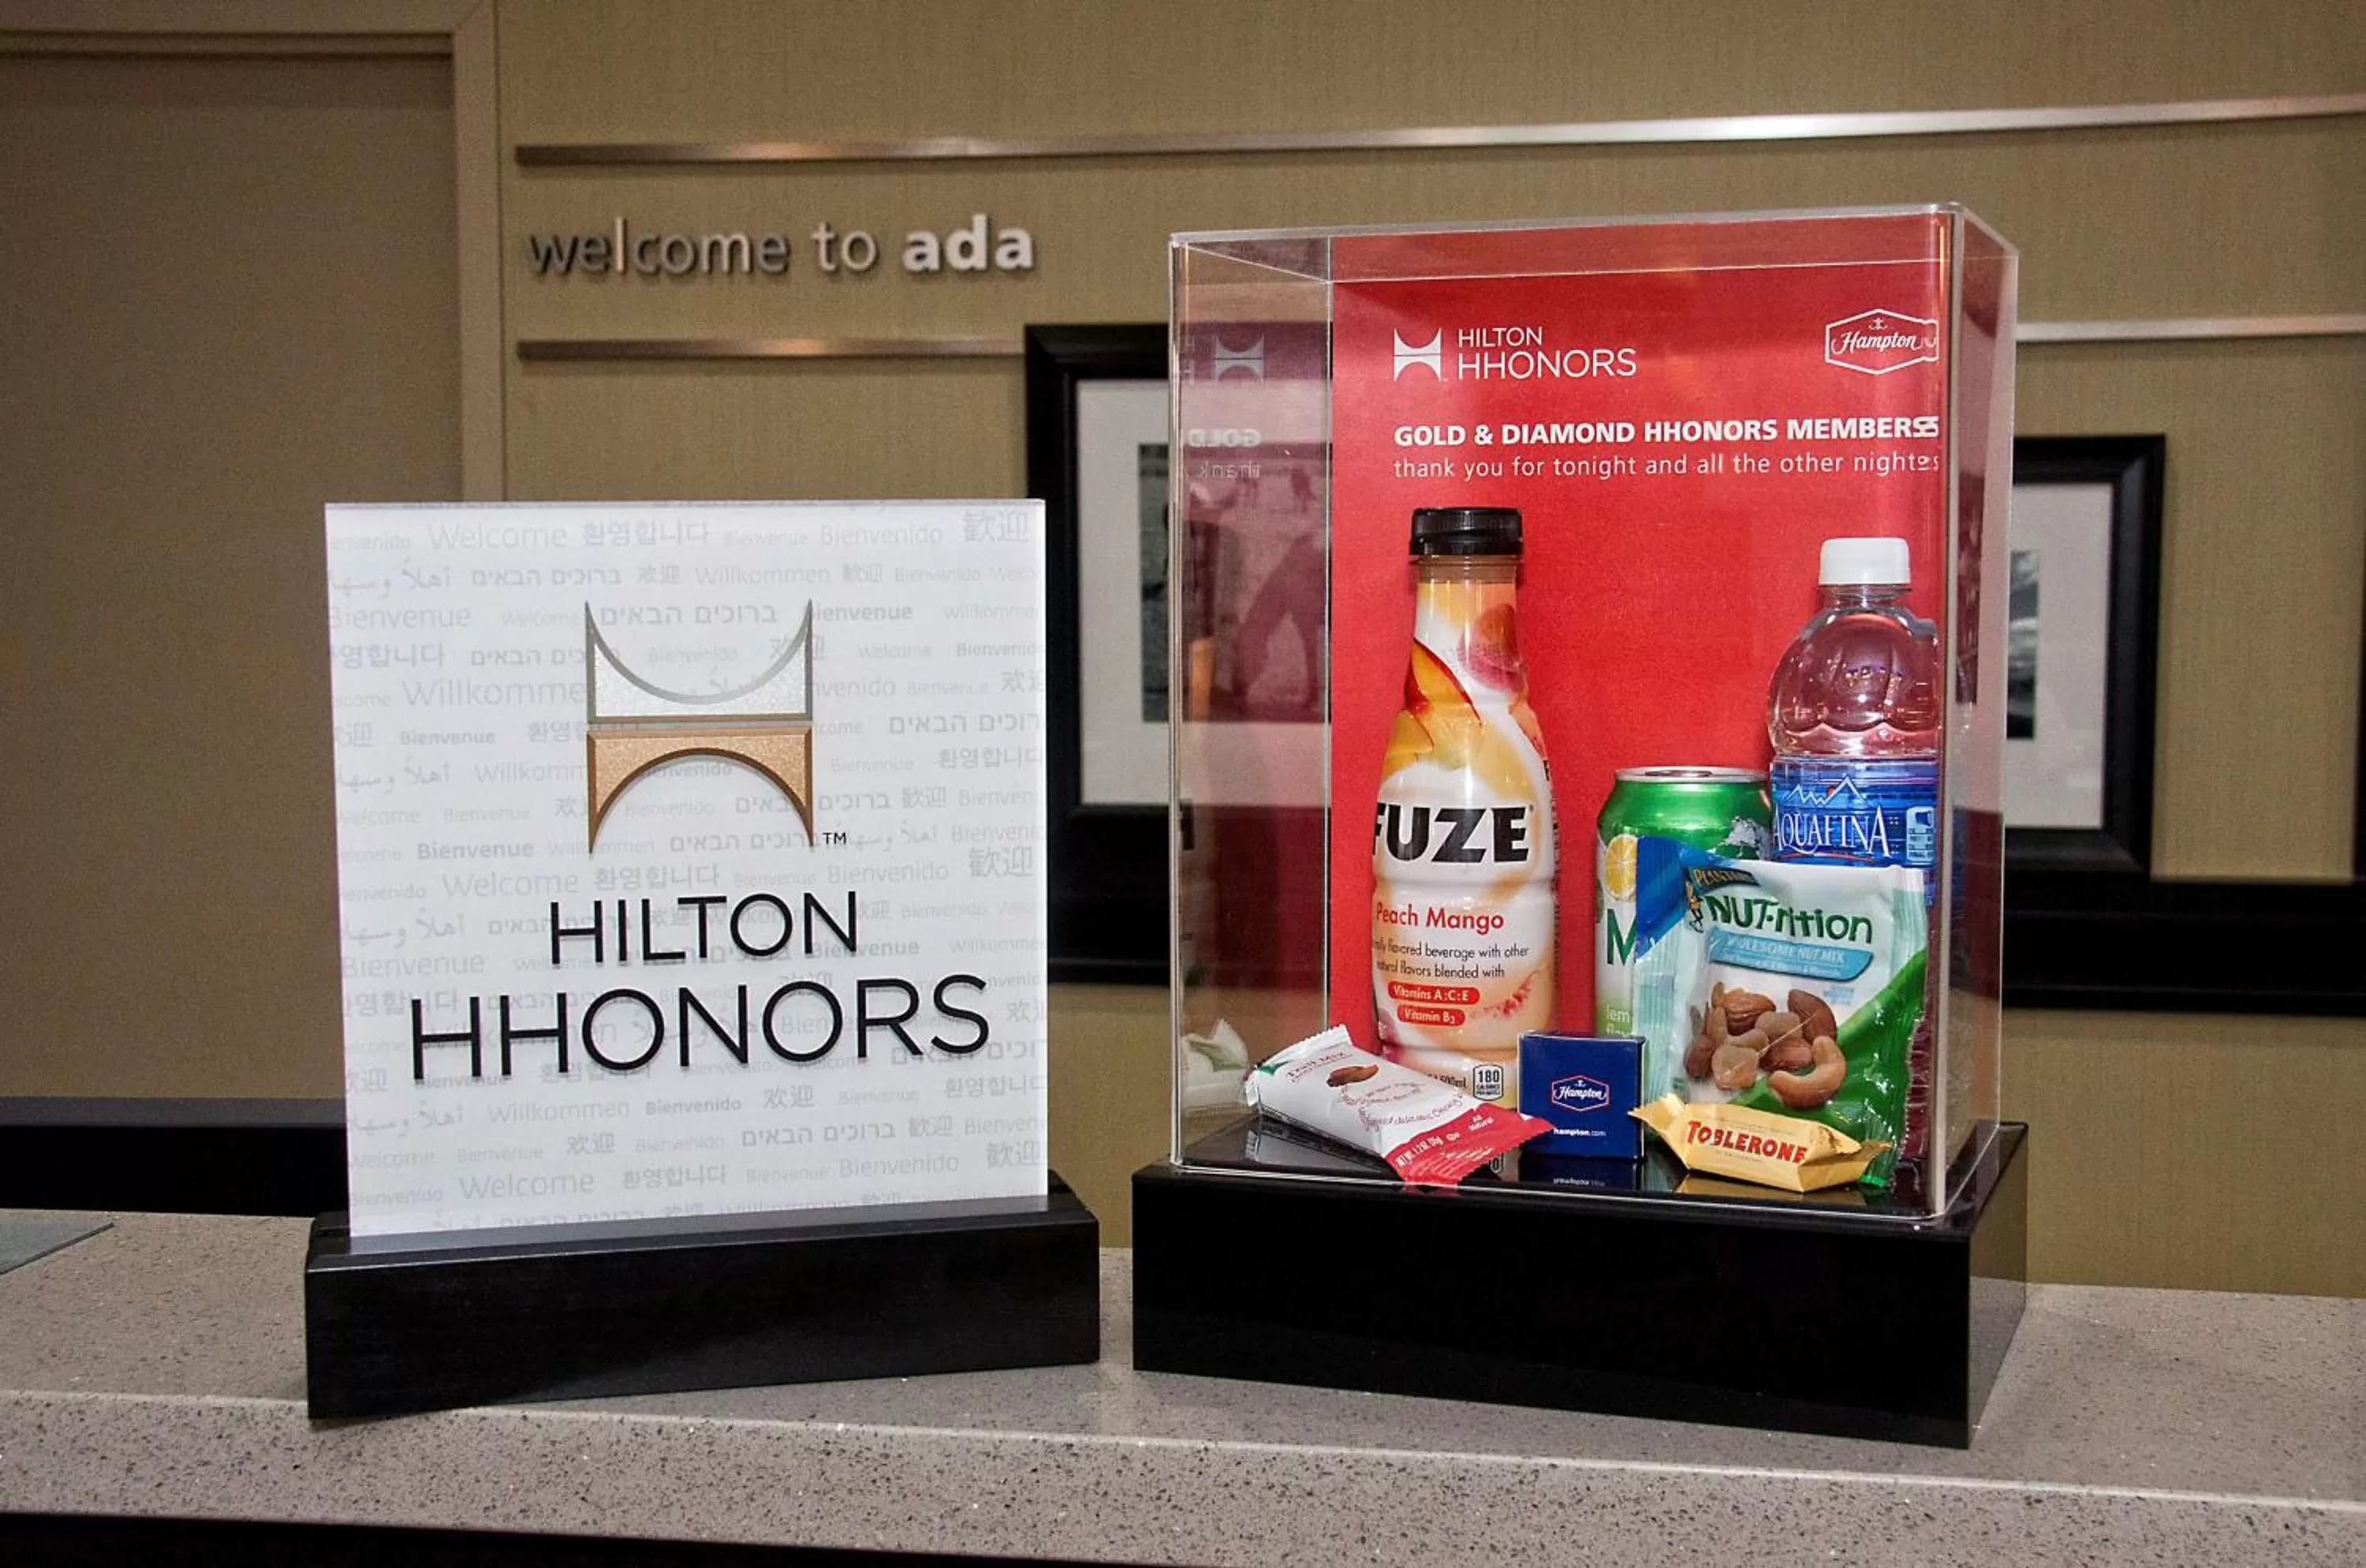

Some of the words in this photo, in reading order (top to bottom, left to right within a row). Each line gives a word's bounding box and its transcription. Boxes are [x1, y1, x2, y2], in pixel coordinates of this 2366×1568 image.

[531, 217, 788, 274] welcome
[813, 221, 877, 272] to
[902, 214, 1034, 271] ada
[1458, 326, 1543, 348] HILTON
[1831, 331, 1931, 354] Hampton
[1458, 348, 1637, 379] HHONORS
[1394, 425, 1466, 446] GOLD
[1474, 424, 1493, 445] &
[1502, 421, 1635, 444] DIAMOND
[1644, 419, 1778, 442] HHONORS
[1394, 457, 1454, 477] thank
[1465, 461, 1502, 481] you
[1513, 455, 1545, 476] for
[1554, 454, 1635, 480] tonight
[1645, 454, 1687, 475] and
[1697, 452, 1723, 474] all
[1733, 452, 1771, 474] the
[1780, 453, 1843, 474] other
[428, 523, 568, 549] Welcome
[583, 520, 711, 546] 환영합니다
[820, 524, 944, 546] Bienvenido
[472, 568, 542, 588] הבאים
[552, 566, 621, 586] ברוכים
[694, 566, 832, 584] Willkommen
[600, 606, 683, 625] הבאים
[695, 605, 778, 625] ברוכים
[806, 603, 913, 622] ienvenue
[338, 643, 444, 669] 영합니다
[471, 647, 542, 666] הבאים
[402, 678, 586, 706] Willkomme
[812, 678, 898, 698] nvenido
[817, 721, 864, 736] come
[889, 715, 968, 734] הבאים
[401, 730, 497, 745] Bienvenue
[818, 793, 892, 811] ברוכים
[670, 834, 741, 853] הבאים
[822, 831, 847, 846] TM
[1371, 801, 1530, 864] FUZE
[416, 842, 535, 861] Bienvenue
[593, 864, 718, 891] 환영합니다
[827, 861, 950, 884] Bienvenido
[442, 872, 579, 896] Welcome
[550, 890, 857, 967] HILTON
[1376, 902, 1418, 927] Peach
[1426, 907, 1504, 935] Mango
[813, 941, 920, 958] Bievenue
[1425, 942, 1475, 961] beverage
[1478, 943, 1501, 958] with
[1504, 943, 1529, 957] other
[1822, 950, 1844, 963] MIX
[343, 954, 485, 978] Bienvenue
[1401, 960, 1431, 976] flavors
[1435, 963, 1479, 979] blended
[1482, 963, 1505, 979] with
[1394, 984, 1431, 1000] Vitamins
[1404, 1007, 1440, 1022] Vitamin
[411, 973, 990, 1085] HHONORS
[1478, 1070, 1500, 1083] 180
[763, 1084, 815, 1110] 欢迎
[1554, 1086, 1607, 1100] Hampton
[488, 1099, 630, 1123] Willkommen
[644, 1097, 742, 1116] Bienvenido
[741, 1126, 813, 1148] הבאים
[824, 1121, 897, 1143] ברוכים
[1686, 1120, 1808, 1163] TOBLERONE
[622, 1163, 726, 1190] 환영합니다
[839, 1154, 961, 1178] Bienvenido
[457, 1172, 594, 1199] Welcome
